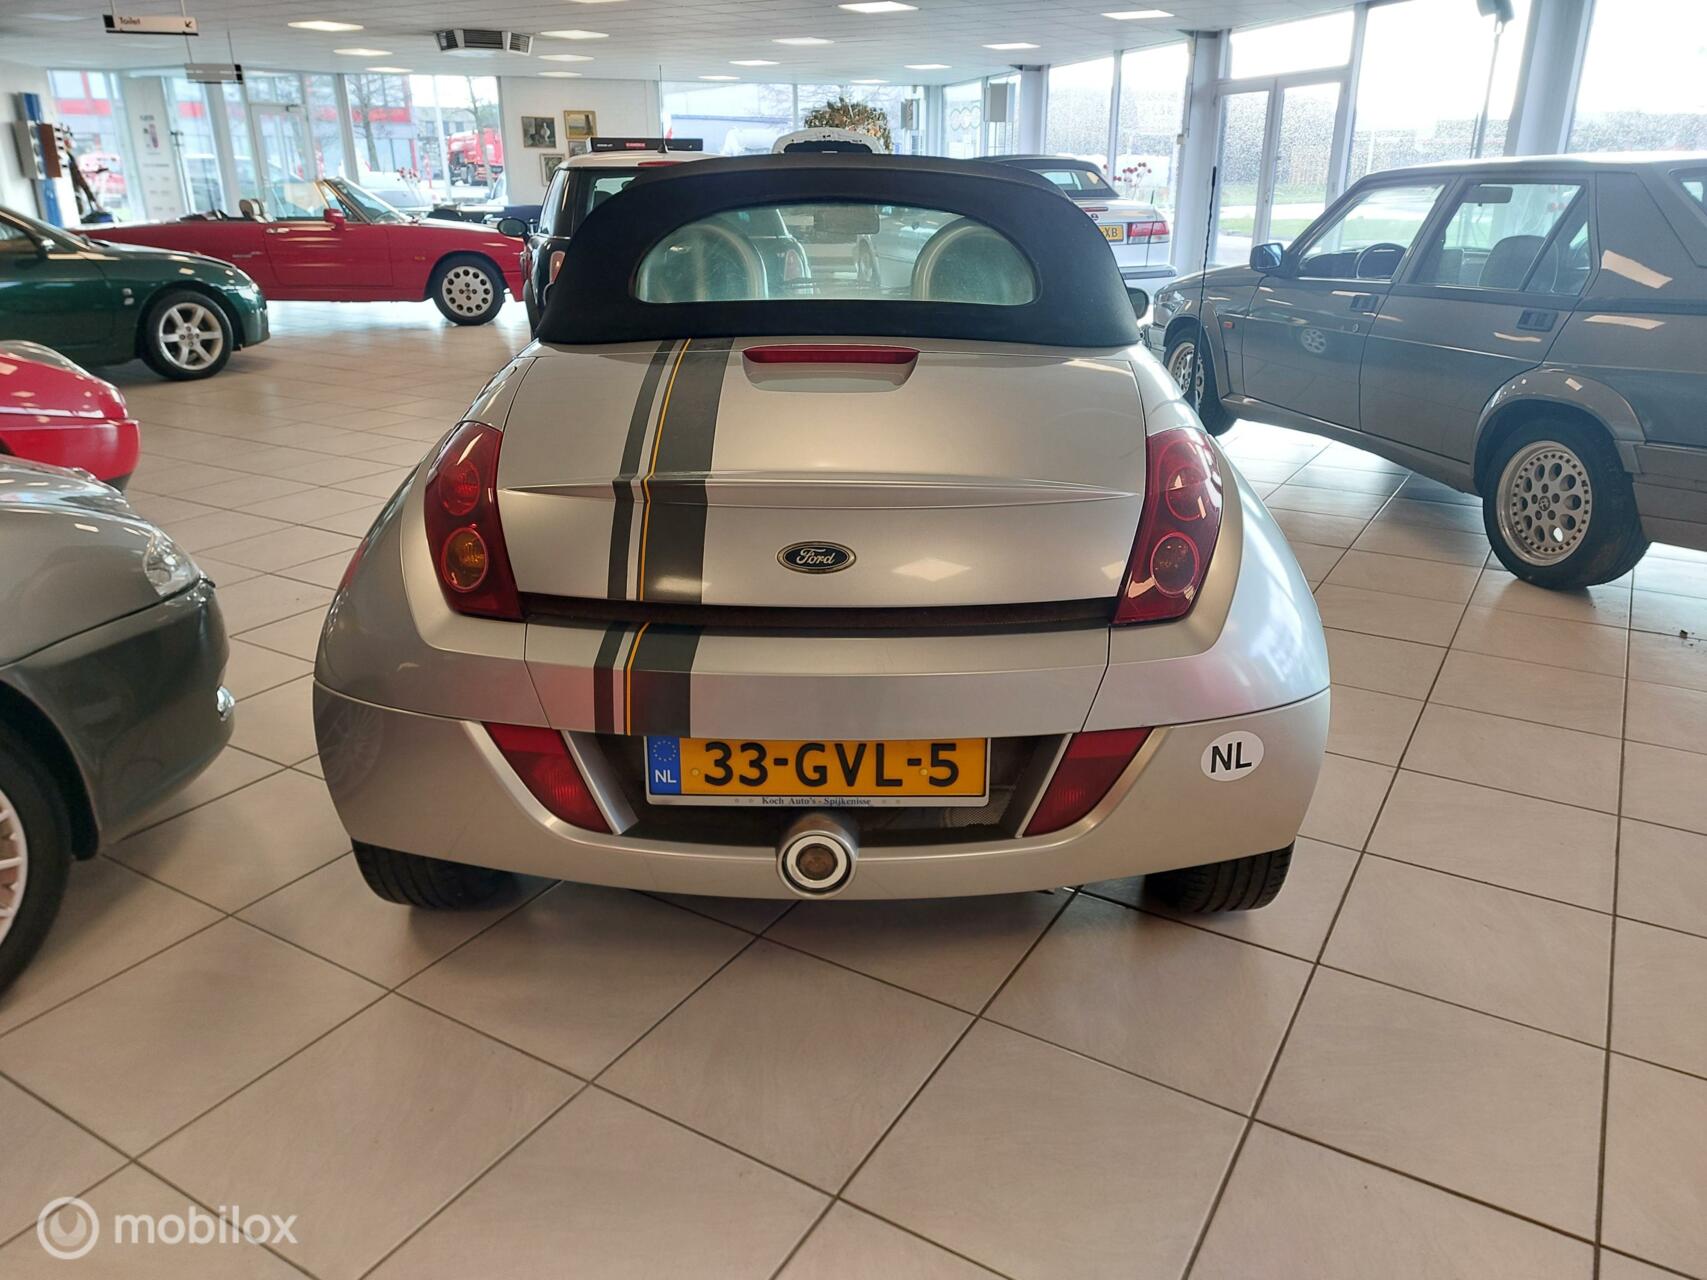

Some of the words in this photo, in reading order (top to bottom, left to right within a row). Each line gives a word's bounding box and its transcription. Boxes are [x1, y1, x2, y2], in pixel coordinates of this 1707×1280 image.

[1101, 227, 1119, 238] XB
[796, 547, 836, 564] Ford
[704, 741, 960, 787] 33-GVL-5
[1211, 741, 1252, 773] NL
[654, 769, 677, 783] NL
[761, 797, 784, 805] Koch
[788, 797, 816, 805] Auto's
[823, 797, 872, 808] Spijkenisse
